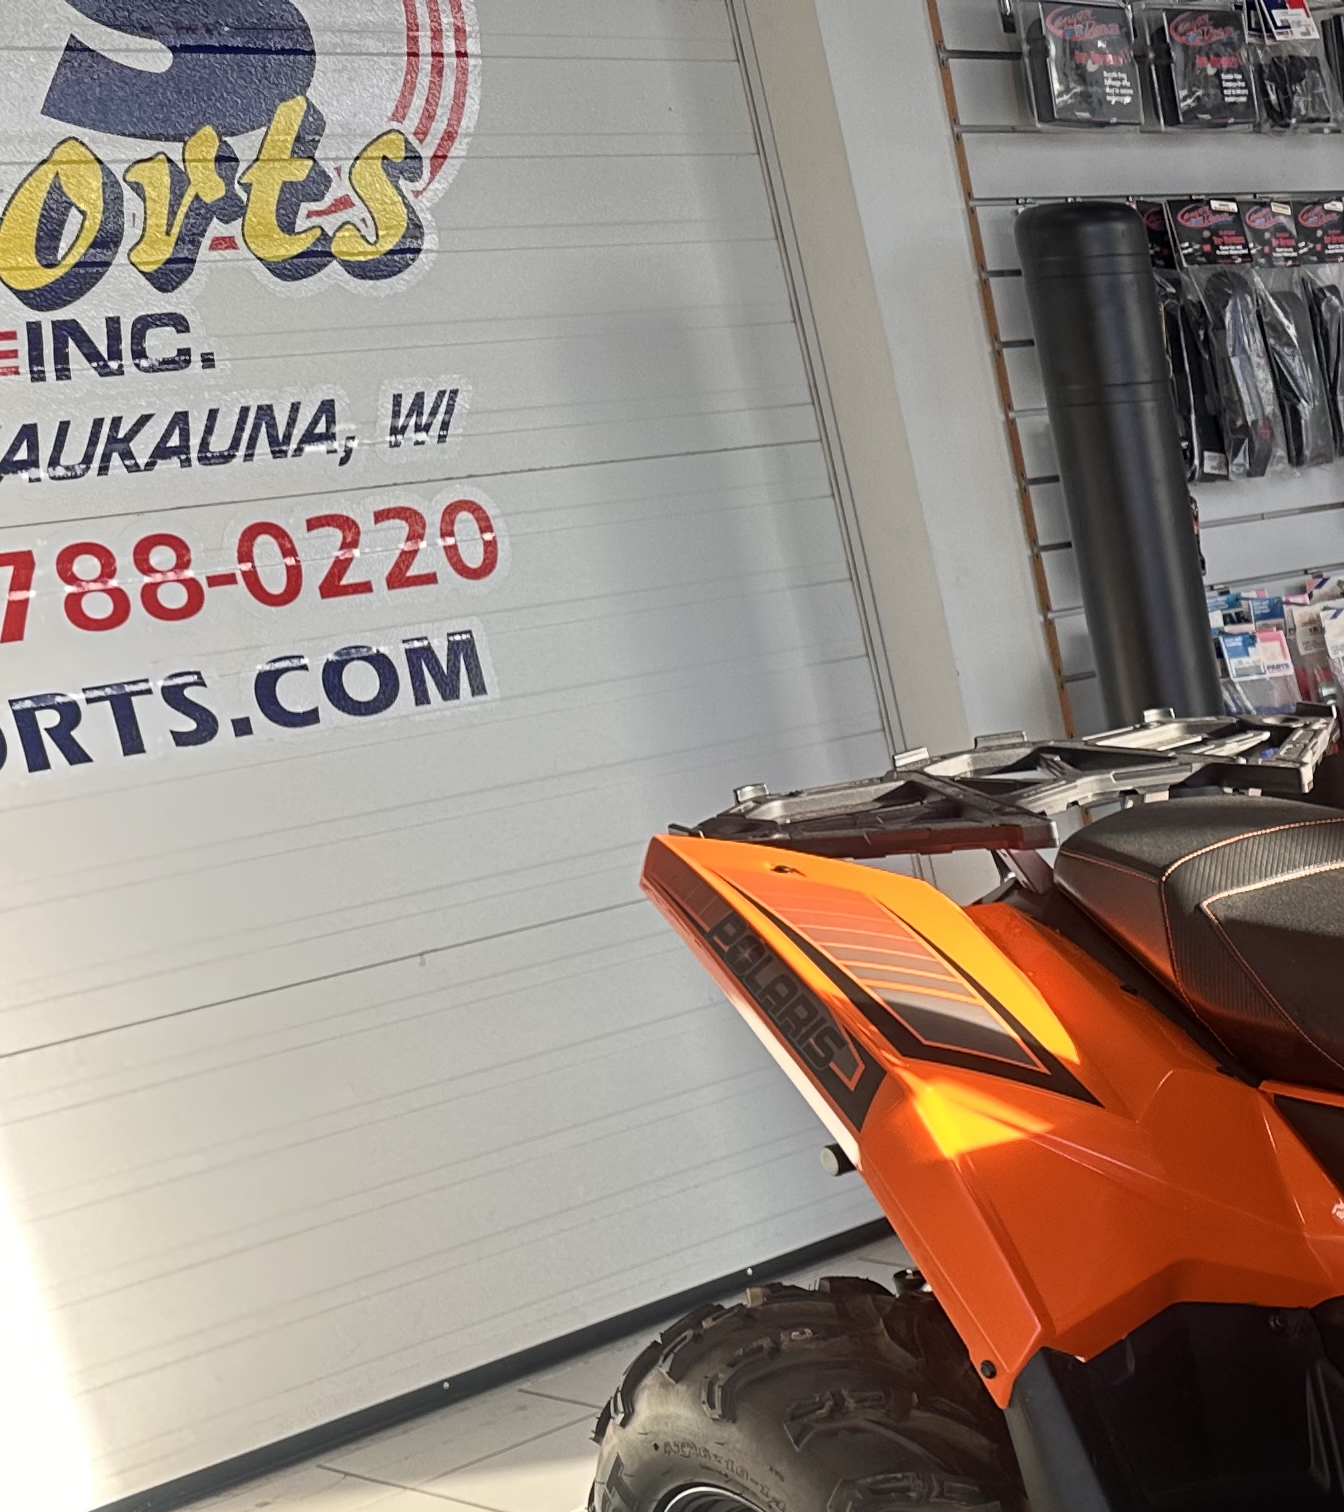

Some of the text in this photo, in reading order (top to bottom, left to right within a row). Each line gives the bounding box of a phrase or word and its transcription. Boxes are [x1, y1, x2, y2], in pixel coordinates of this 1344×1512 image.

[25, 312, 215, 383] INC.
[388, 387, 460, 448] WI
[0, 498, 499, 643] 788-0220
[0, 629, 487, 773] RTS.COM
[706, 911, 848, 1071] POLARIS
